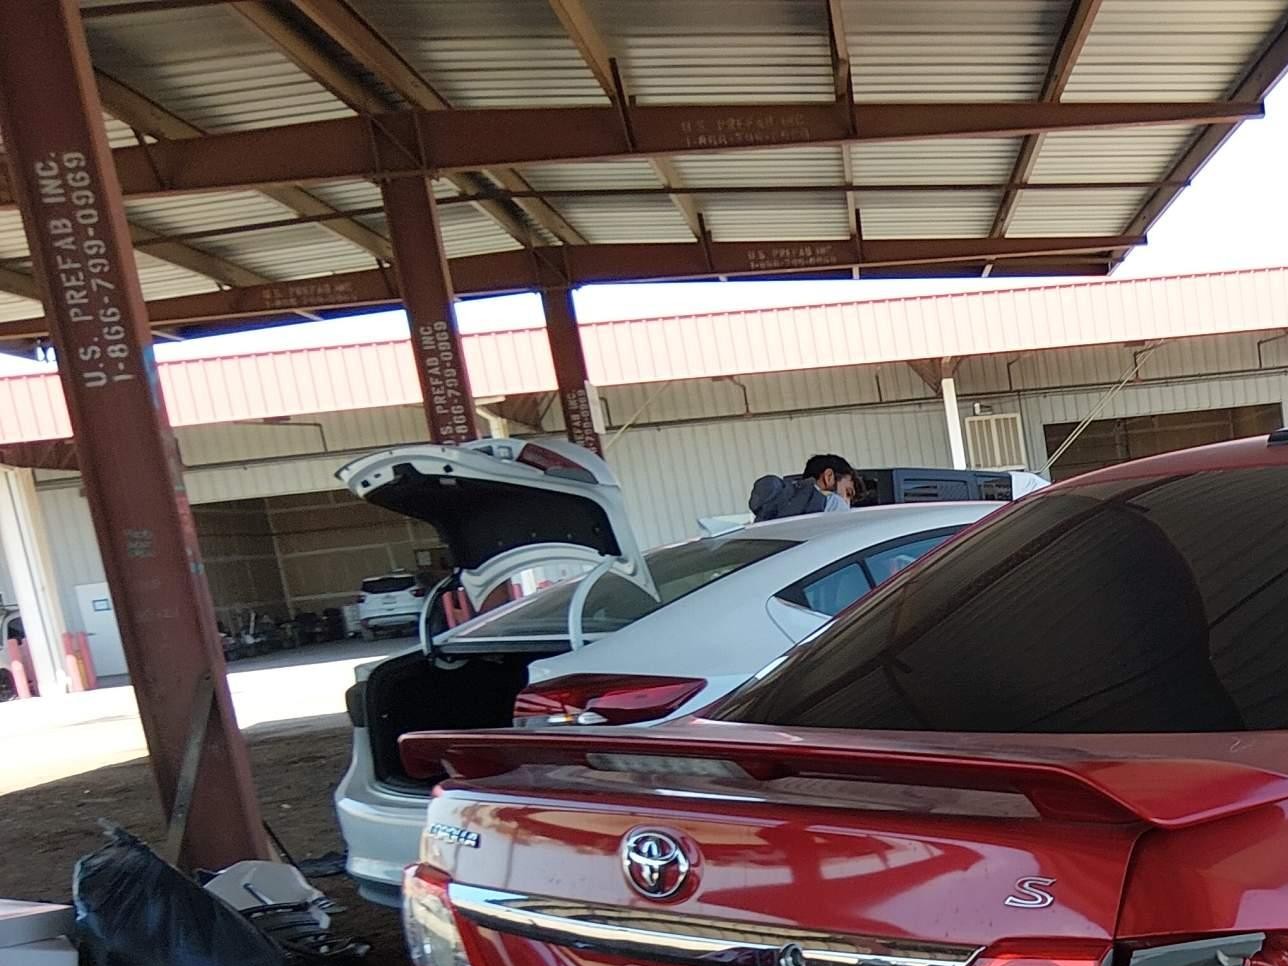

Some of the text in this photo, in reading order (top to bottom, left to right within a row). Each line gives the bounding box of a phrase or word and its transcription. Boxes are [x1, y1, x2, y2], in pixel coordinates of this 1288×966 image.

[35, 152, 108, 388] U.S. PREFAB INC.
[63, 151, 134, 383] 1-866-799-0969
[433, 320, 469, 440] -866-799-0969
[1003, 875, 1056, 909] S
